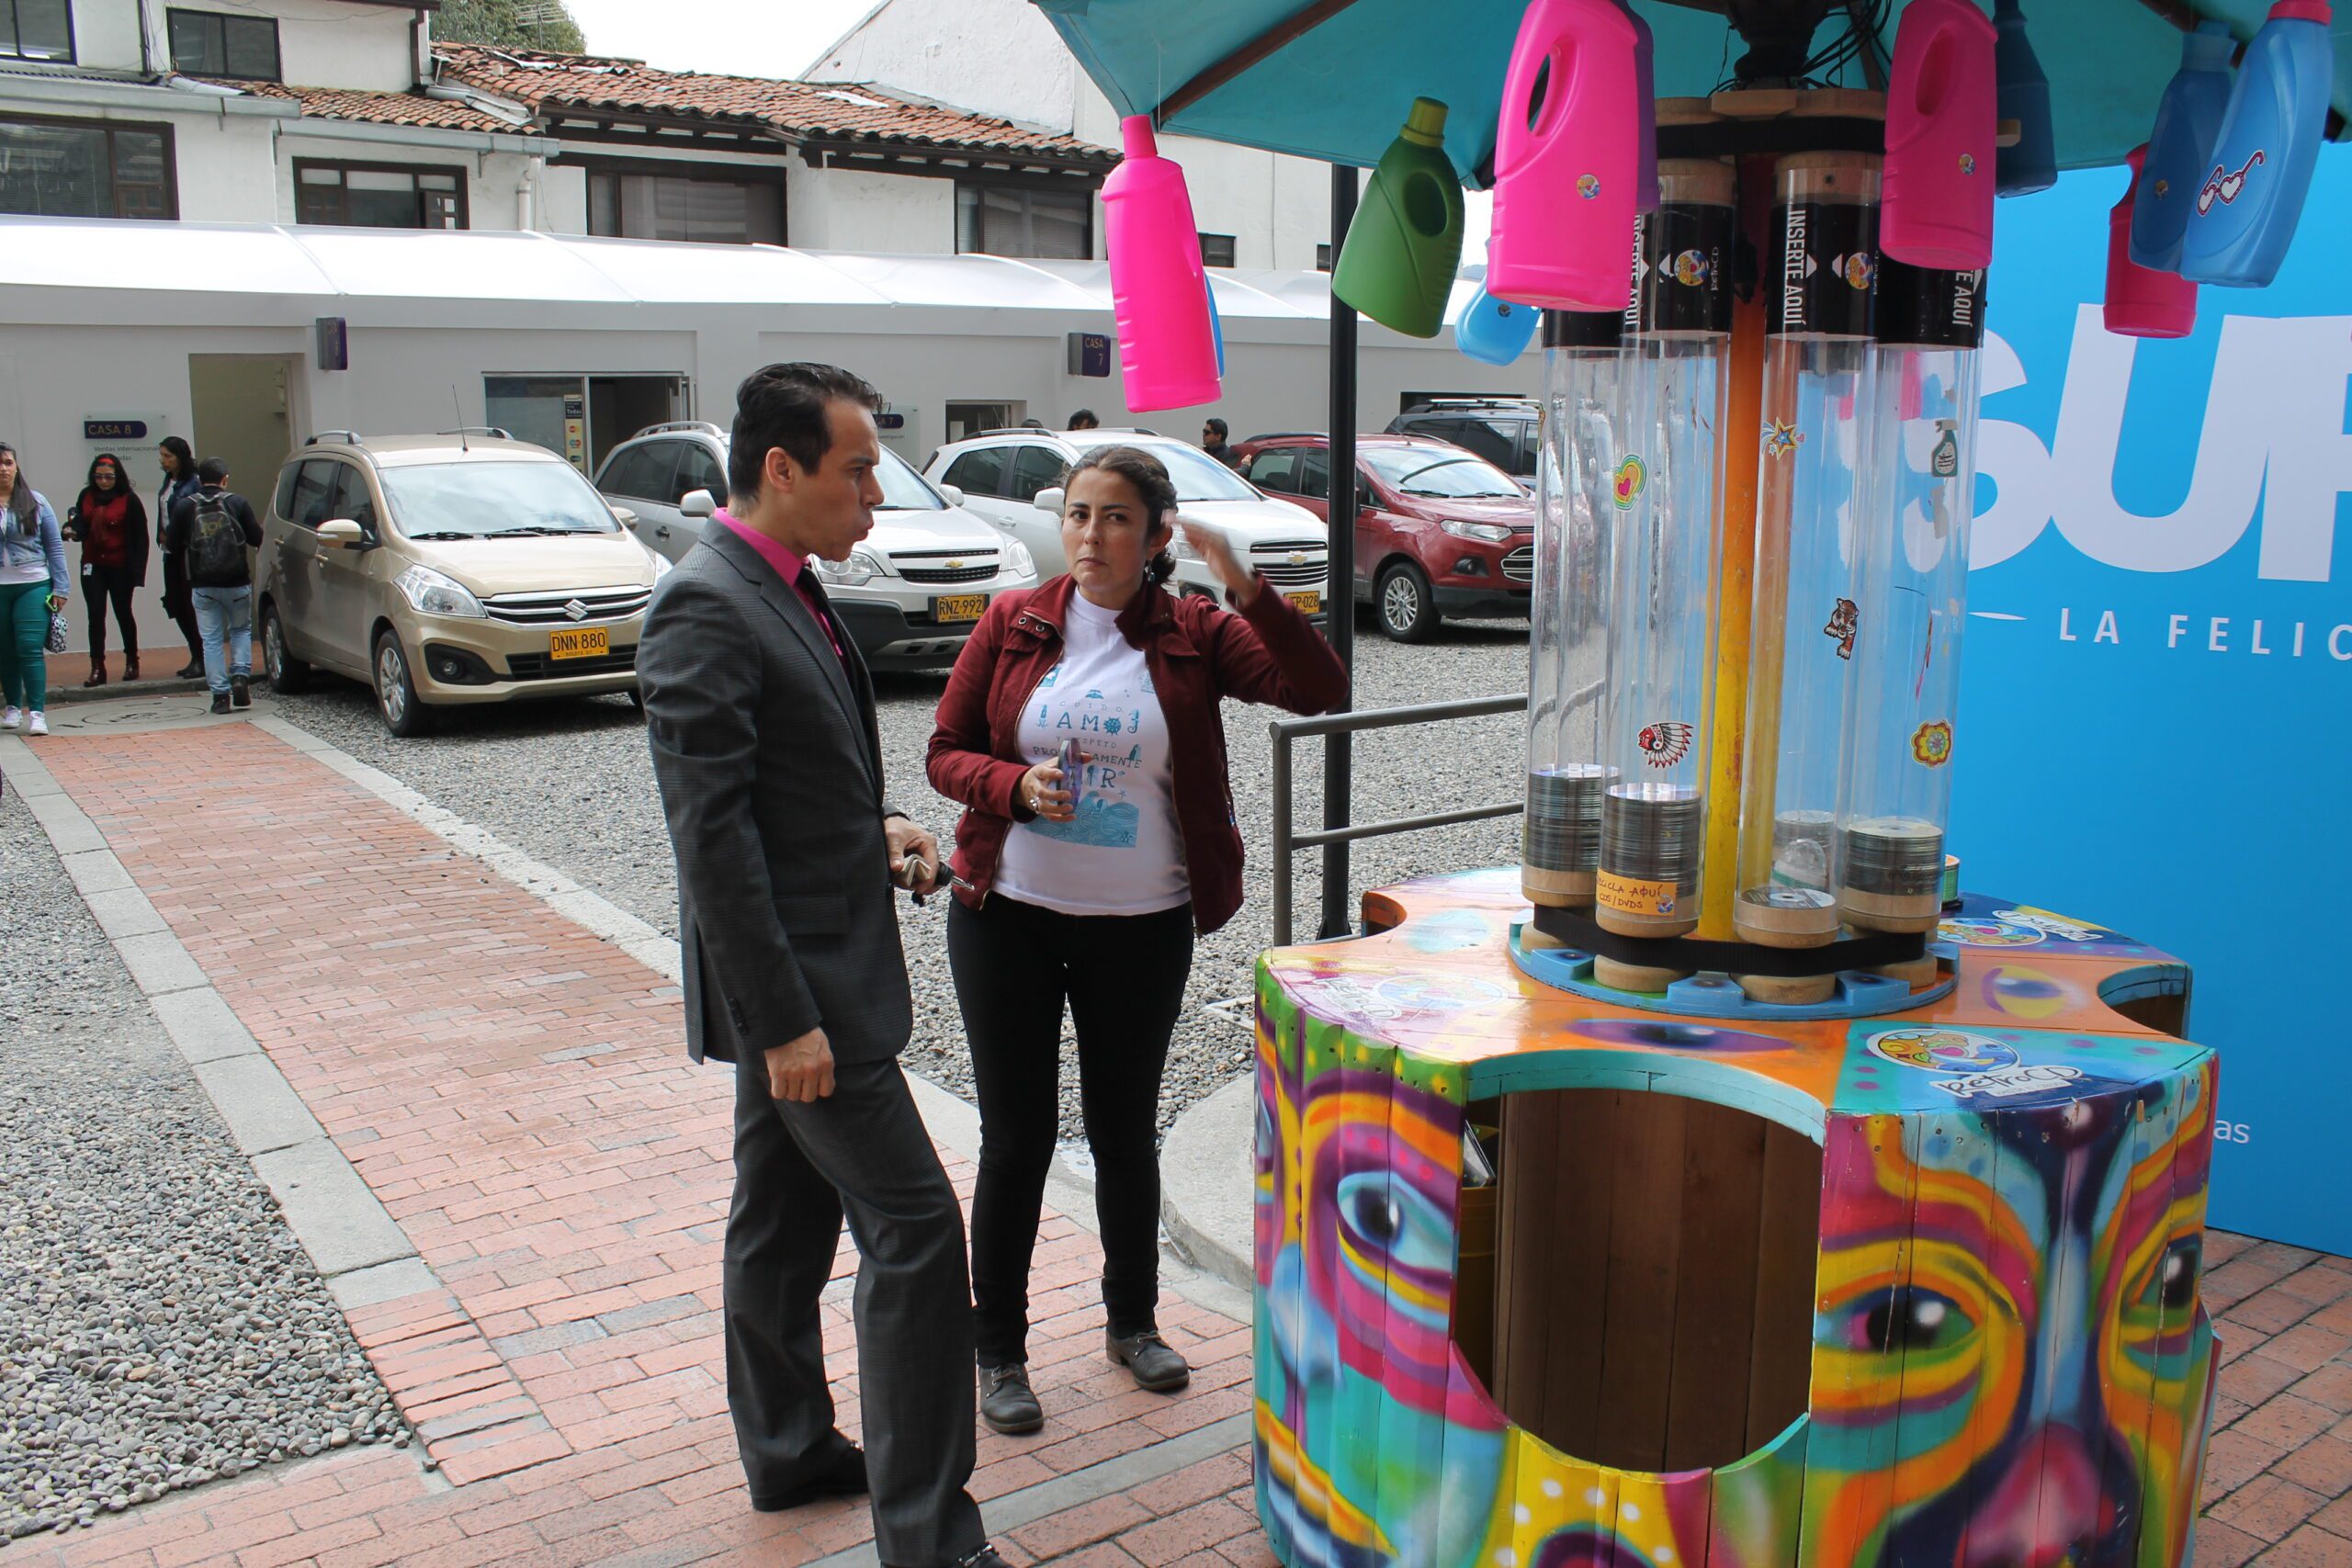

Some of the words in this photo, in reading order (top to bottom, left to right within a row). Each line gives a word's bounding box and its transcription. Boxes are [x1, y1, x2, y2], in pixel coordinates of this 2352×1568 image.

[1785, 209, 1806, 279] INSERTE
[1784, 285, 1806, 325] AQUÍ
[1952, 286, 1973, 327] AQUÍ
[1085, 337, 1103, 348] CASA
[1098, 353, 1103, 367] 7
[88, 424, 121, 434] CASA
[124, 424, 132, 434] 8
[2059, 607, 2120, 645] LA
[551, 635, 578, 652] DNN
[581, 632, 606, 649] 880
[1939, 1066, 2081, 1096] RetroCD
